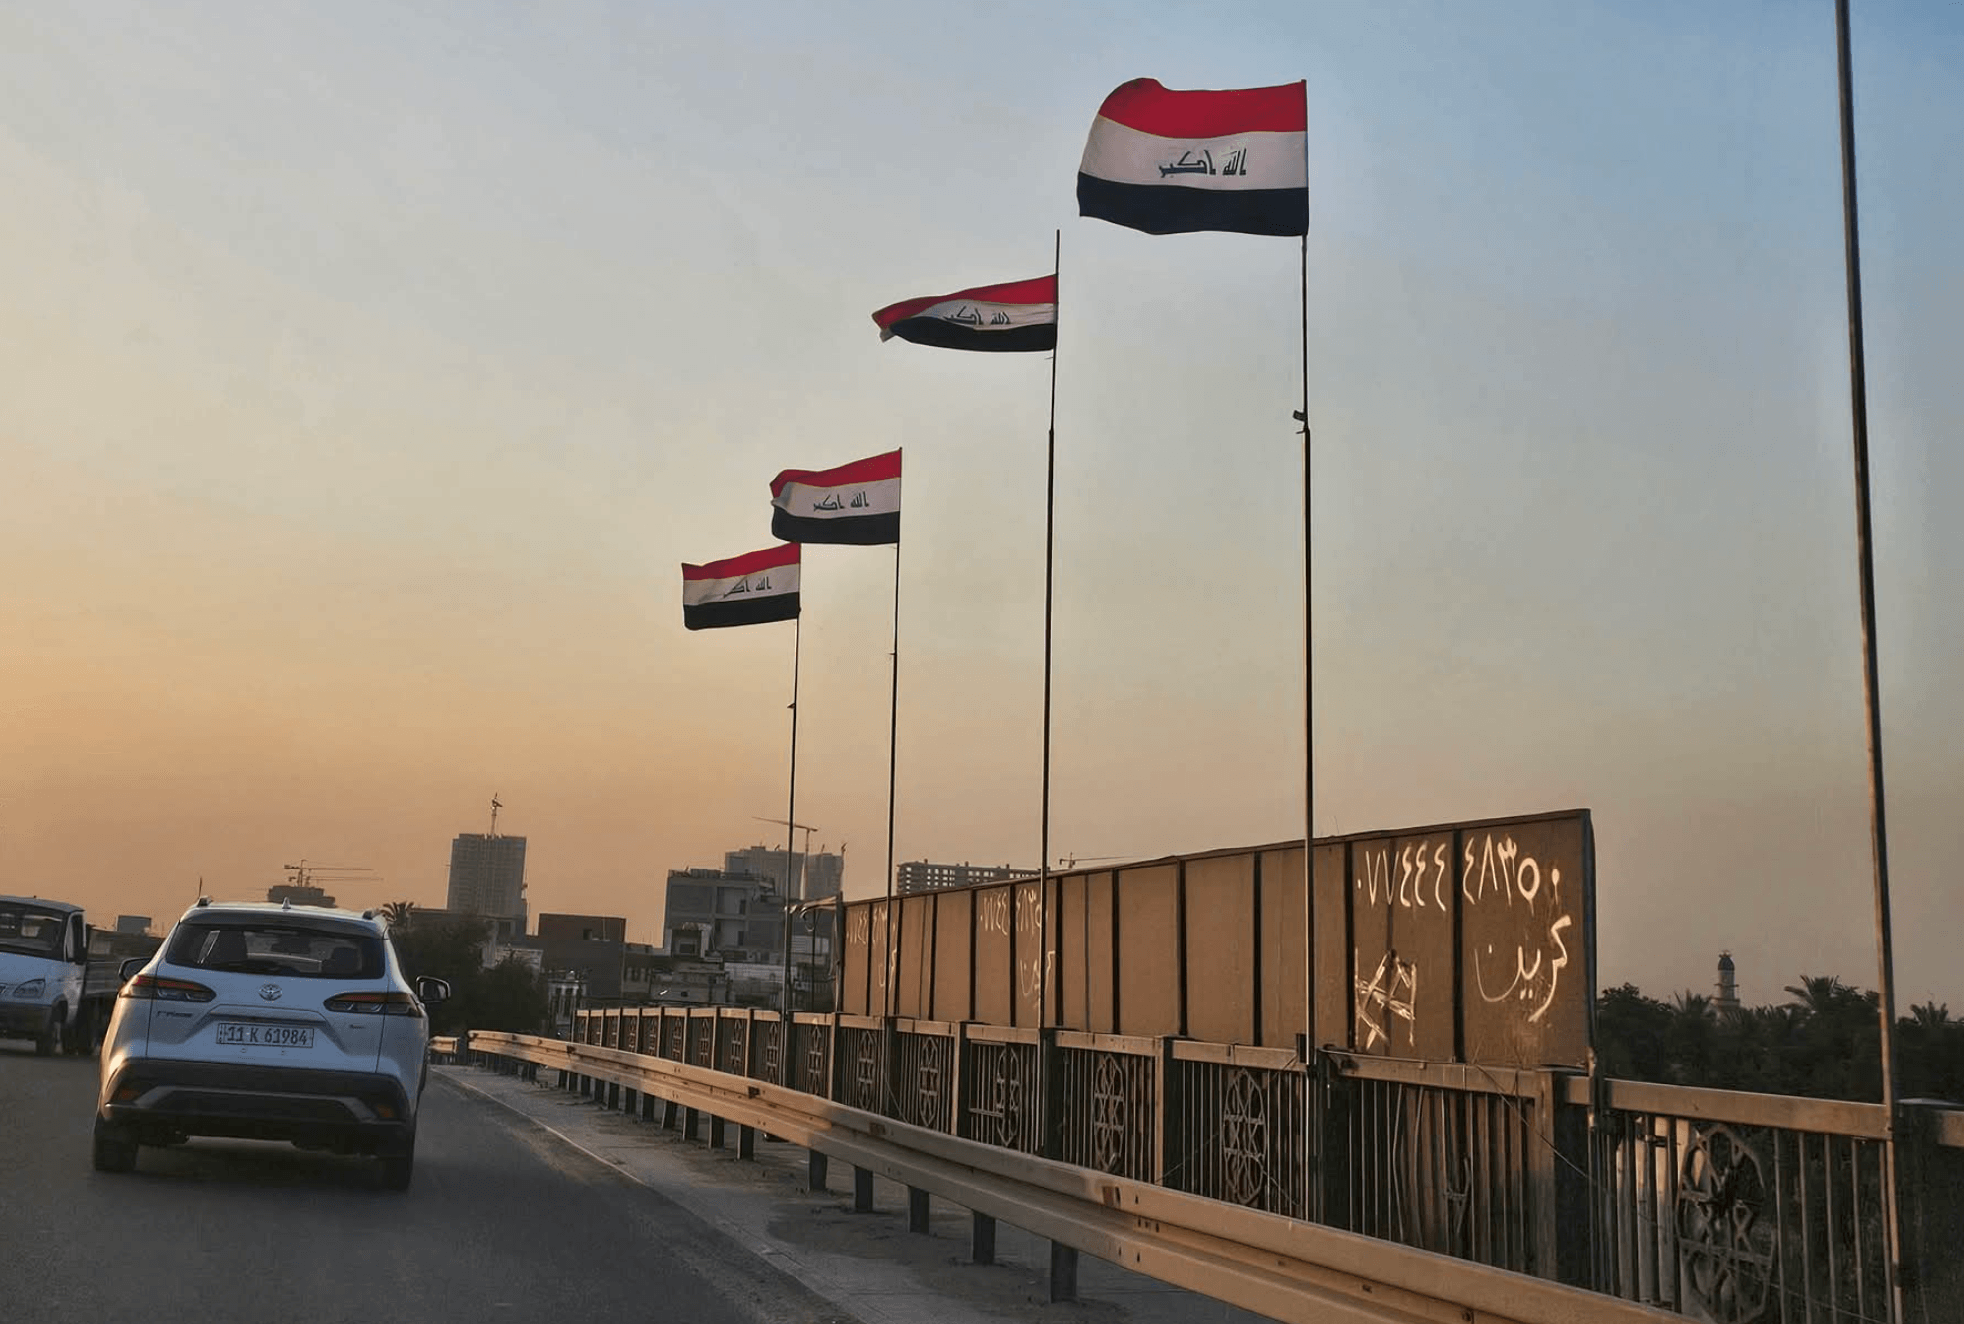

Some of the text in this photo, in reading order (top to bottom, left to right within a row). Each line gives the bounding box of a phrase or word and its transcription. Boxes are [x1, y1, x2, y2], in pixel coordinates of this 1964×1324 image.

[1222, 148, 1246, 176] الله
[850, 491, 870, 508] الله
[227, 1026, 243, 1042] 11
[249, 1027, 259, 1043] K
[264, 1028, 308, 1045] 61984
